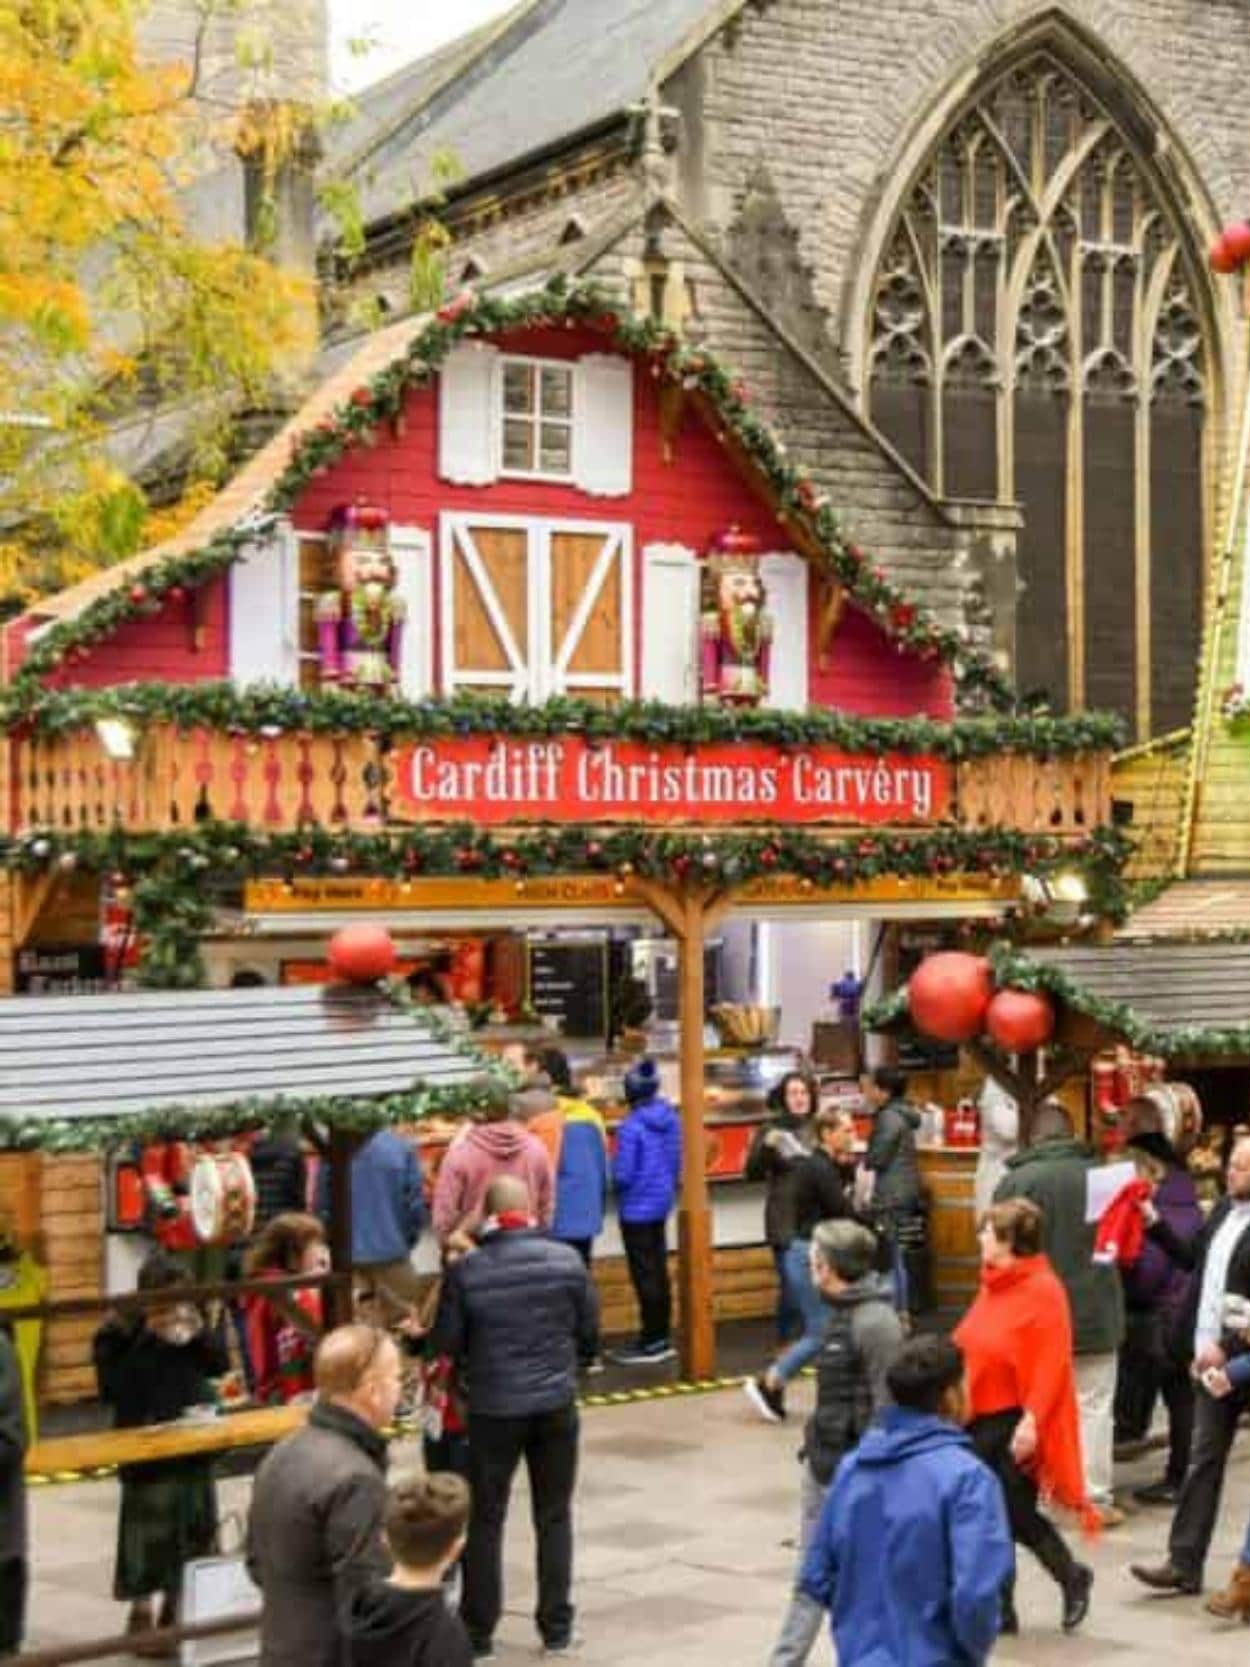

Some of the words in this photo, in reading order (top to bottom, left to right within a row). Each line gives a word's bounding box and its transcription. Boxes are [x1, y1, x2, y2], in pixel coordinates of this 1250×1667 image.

[411, 741, 563, 801] Cardiff
[577, 747, 776, 802] Christmas
[792, 754, 932, 818] Carvery
